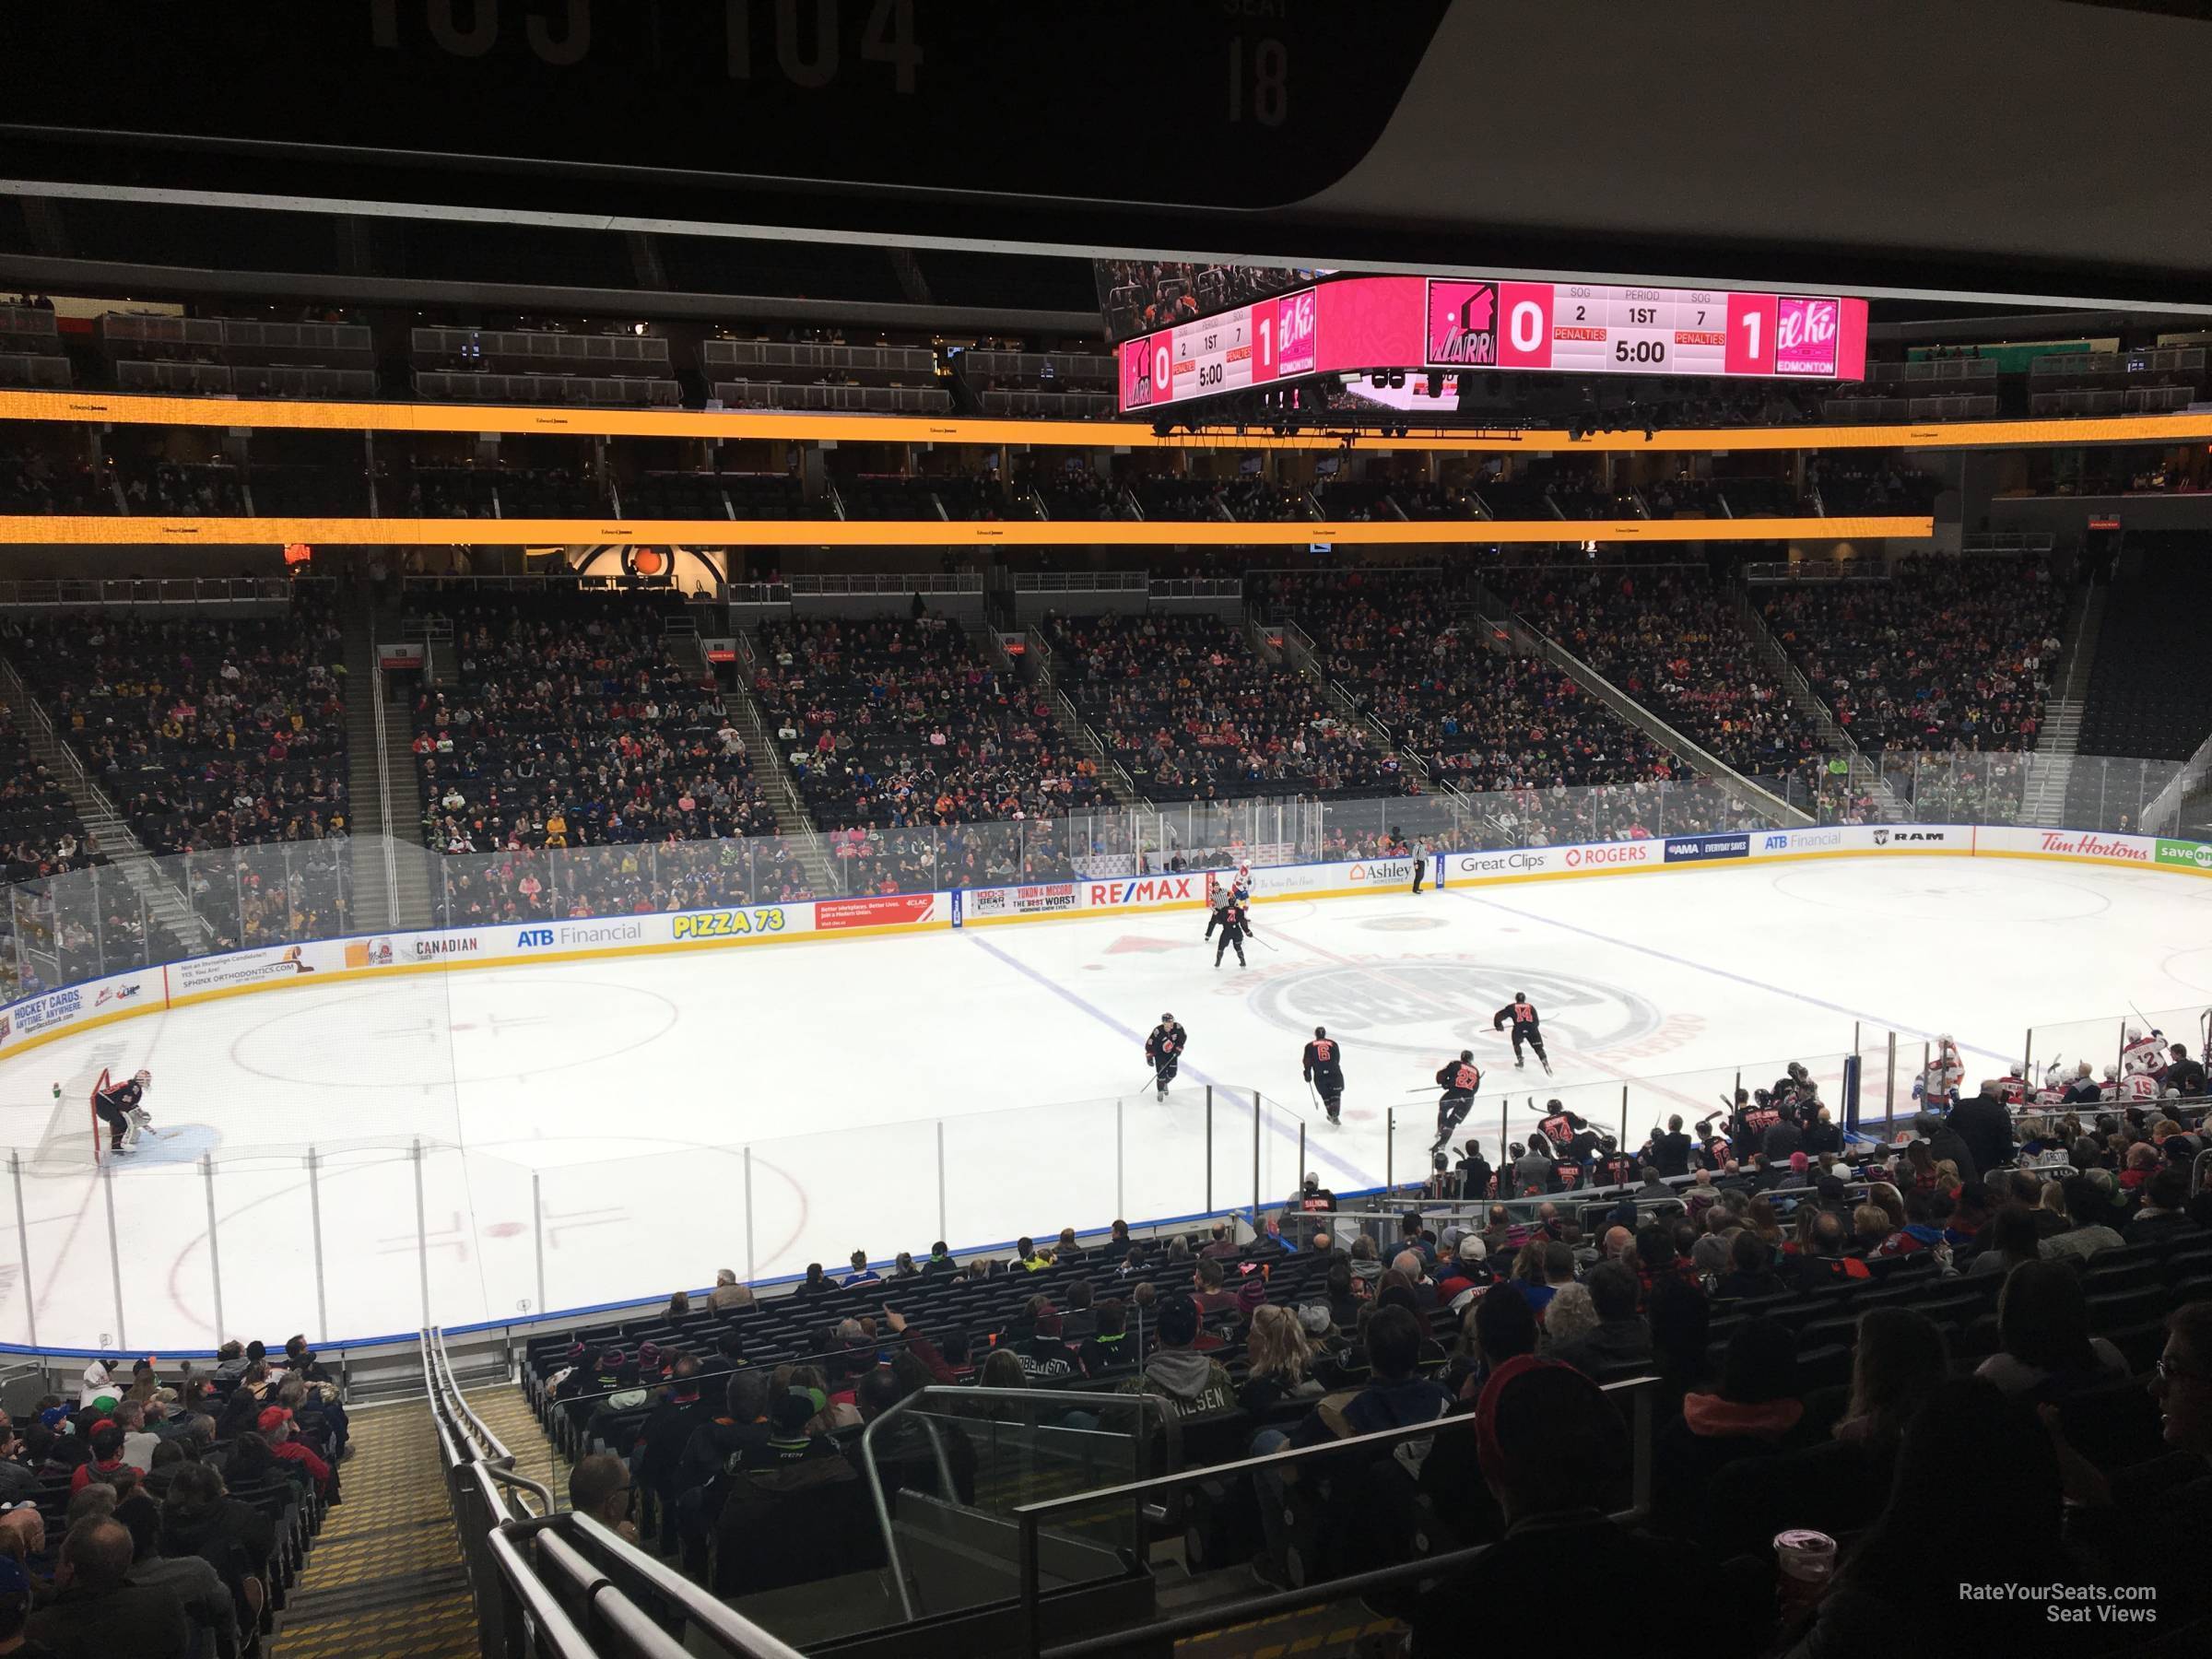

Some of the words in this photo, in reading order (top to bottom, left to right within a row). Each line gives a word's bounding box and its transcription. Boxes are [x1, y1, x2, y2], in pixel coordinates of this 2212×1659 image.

[1229, 37, 1288, 126] 18
[1571, 288, 1591, 298] SOG
[1625, 290, 1660, 301] PERIOD
[1691, 293, 1711, 303] SOG
[1576, 306, 1585, 321] 2
[1630, 309, 1657, 324] 1ST
[1697, 311, 1705, 325] 7
[1511, 300, 1544, 352] 0
[1237, 328, 1241, 342] 7
[1260, 318, 1270, 366] 1
[1555, 328, 1606, 341] PENALTIES
[1676, 333, 1725, 346] PENALTIES
[1742, 312, 1761, 359] 1
[1182, 344, 1186, 356] 2
[1205, 335, 1218, 350] 1ST
[1227, 347, 1252, 362] PENALTIES
[1616, 340, 1665, 363] 5:00
[1156, 347, 1169, 390] 0
[1173, 361, 1195, 374] PENALTIES
[1280, 358, 1313, 374] EDMONTON
[1778, 361, 1833, 372] EDMONTON
[1200, 363, 1223, 387] 5:00
[1765, 836, 1787, 850] ATB
[1791, 833, 1841, 848] Financial
[1894, 832, 1945, 841] RAM
[1675, 843, 1699, 854] AMA
[1705, 842, 1730, 853] EVERYDAY
[1730, 841, 1747, 851] SAVES
[2041, 832, 2073, 852] Tim
[2076, 835, 2148, 861] Hortons
[1461, 855, 1504, 872] Great
[1509, 853, 1546, 872] Clips
[1585, 847, 1647, 864] ROGERS
[1367, 863, 1412, 879] Ashley
[1018, 887, 1039, 899] YUKON
[1091, 878, 1192, 906] RE/MAX
[980, 897, 1005, 905] BEAR
[1045, 895, 1076, 906] WORST
[673, 912, 752, 939] PIZZA
[755, 909, 785, 932] 73
[517, 929, 554, 947] ATB
[560, 923, 641, 945] Financial
[417, 937, 477, 955] CANADIAN
[183, 977, 211, 988] SPHINX
[15, 999, 47, 1019] HOCKEY
[49, 990, 83, 1008] CARDS.
[1515, 1006, 1534, 1023] 14
[1318, 1045, 1331, 1062] 6
[2135, 1080, 2151, 1095] 15
[1018, 1357, 1071, 1375] OBERTSON
